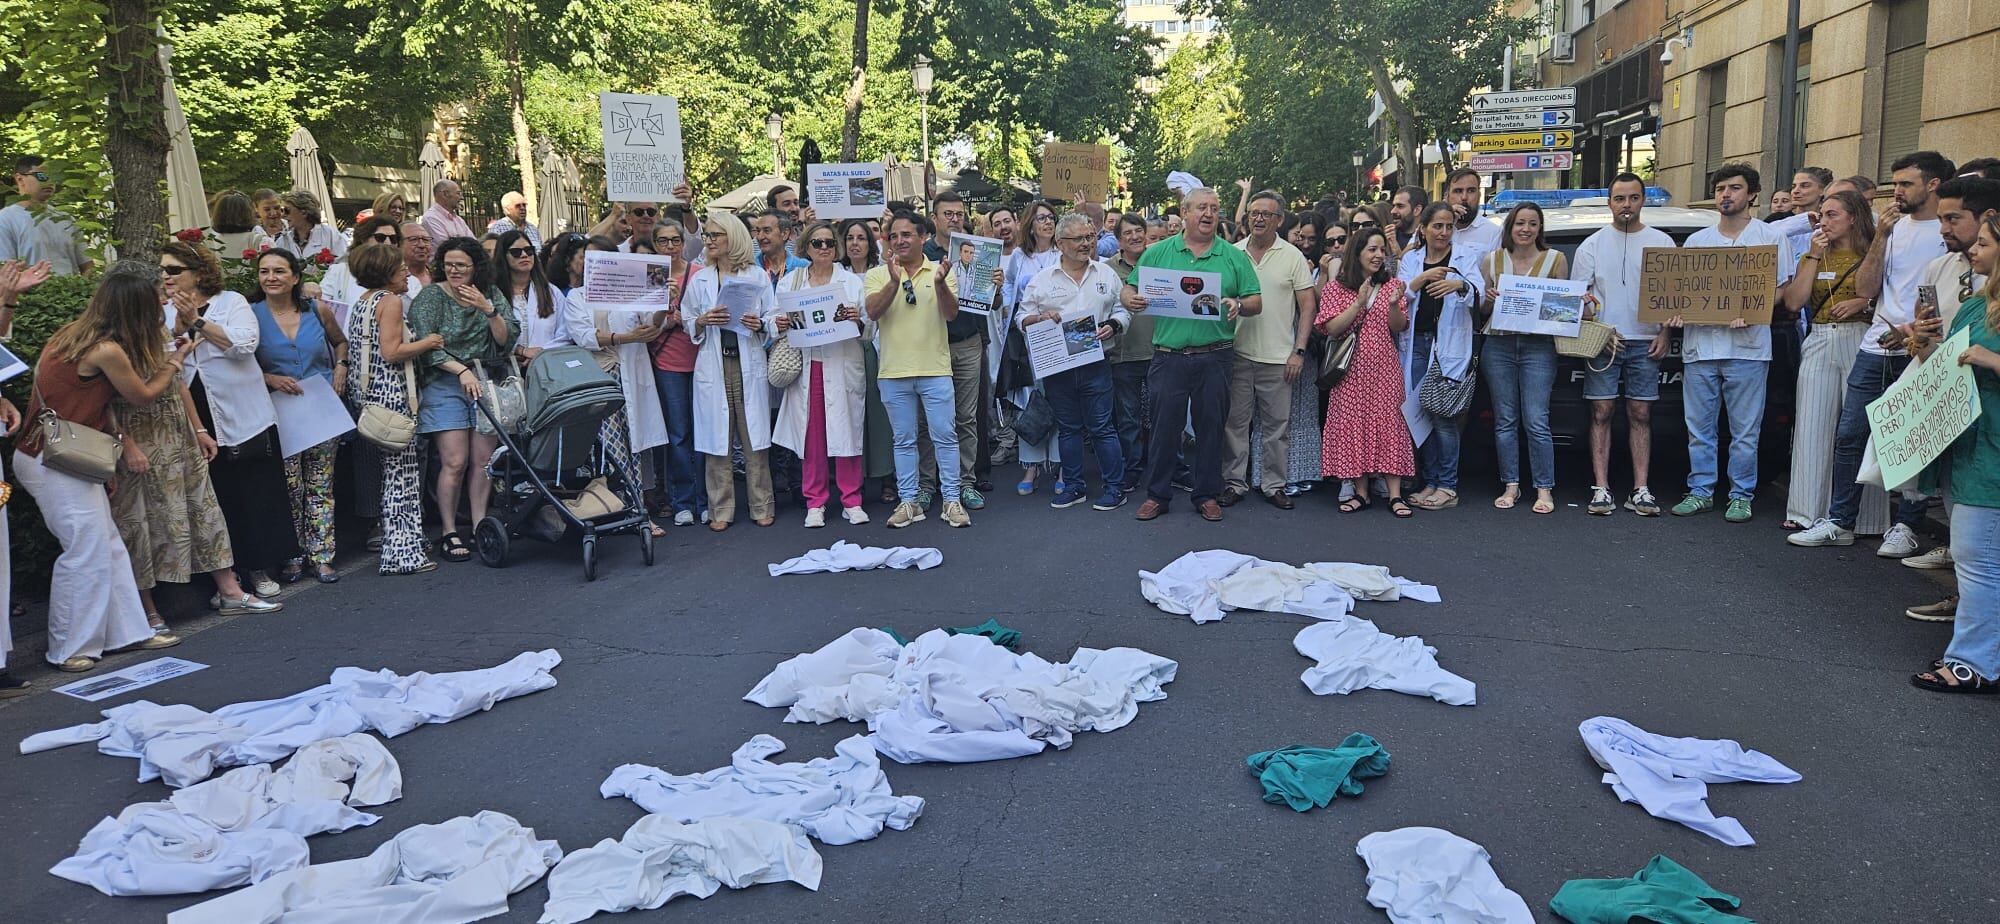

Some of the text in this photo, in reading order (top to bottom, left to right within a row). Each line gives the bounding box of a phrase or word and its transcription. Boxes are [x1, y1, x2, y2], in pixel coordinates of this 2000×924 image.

[1522, 94, 1573, 103] DIRECCIONES
[618, 117, 662, 132] SIVEX
[1474, 115, 1502, 123] hospital
[1473, 134, 1554, 148] parking Galarza P
[609, 152, 678, 163] VETERINARIA Y
[1044, 148, 1078, 164] Pedimos
[1528, 156, 1538, 168] P
[611, 162, 675, 172] FARMACIA EN
[611, 172, 647, 182] CONTRA
[1055, 168, 1072, 181] NO
[612, 181, 653, 194] ESTATUTO
[1645, 252, 1777, 273] ESTATUTO MARCO:
[1515, 282, 1536, 290] BATAS
[1648, 274, 1766, 292] EN JAQUE NUESTRA
[1648, 294, 1765, 311] SALUD Y LA TUYA
[1872, 341, 1954, 424] COBRAMOS POCO
[1880, 367, 1949, 438] PERO AL MENOS
[1879, 375, 1968, 467] TRABAJAMOS
[1919, 400, 1973, 466] MUCHO
